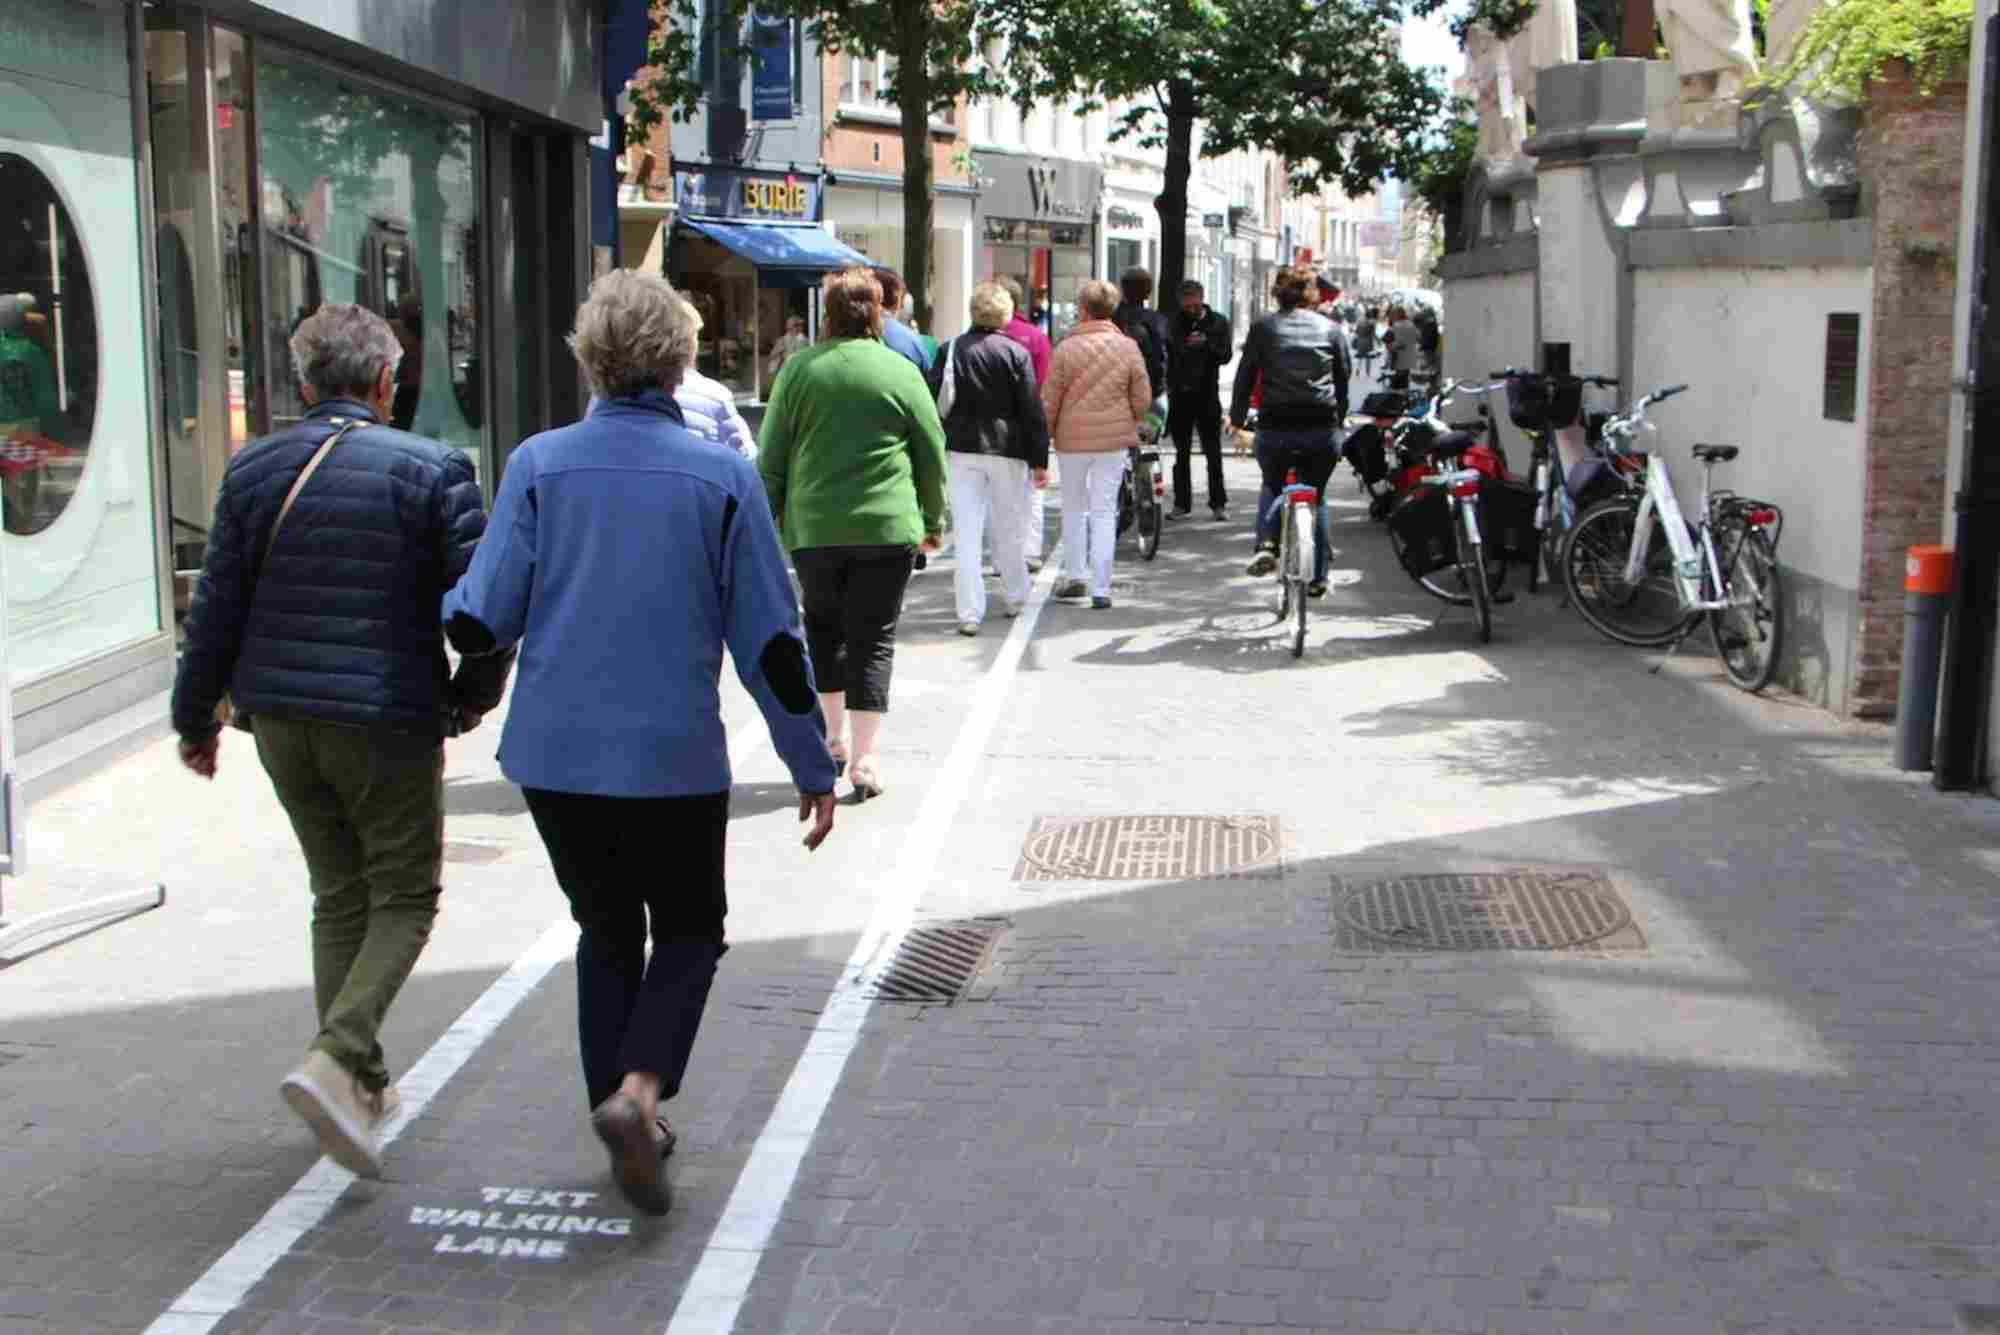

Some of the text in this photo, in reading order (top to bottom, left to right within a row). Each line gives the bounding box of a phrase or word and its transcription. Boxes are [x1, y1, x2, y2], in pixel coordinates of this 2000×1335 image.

[480, 1186, 598, 1208] TEXT
[408, 1206, 632, 1235] WALKING
[433, 1233, 569, 1258] LANE
